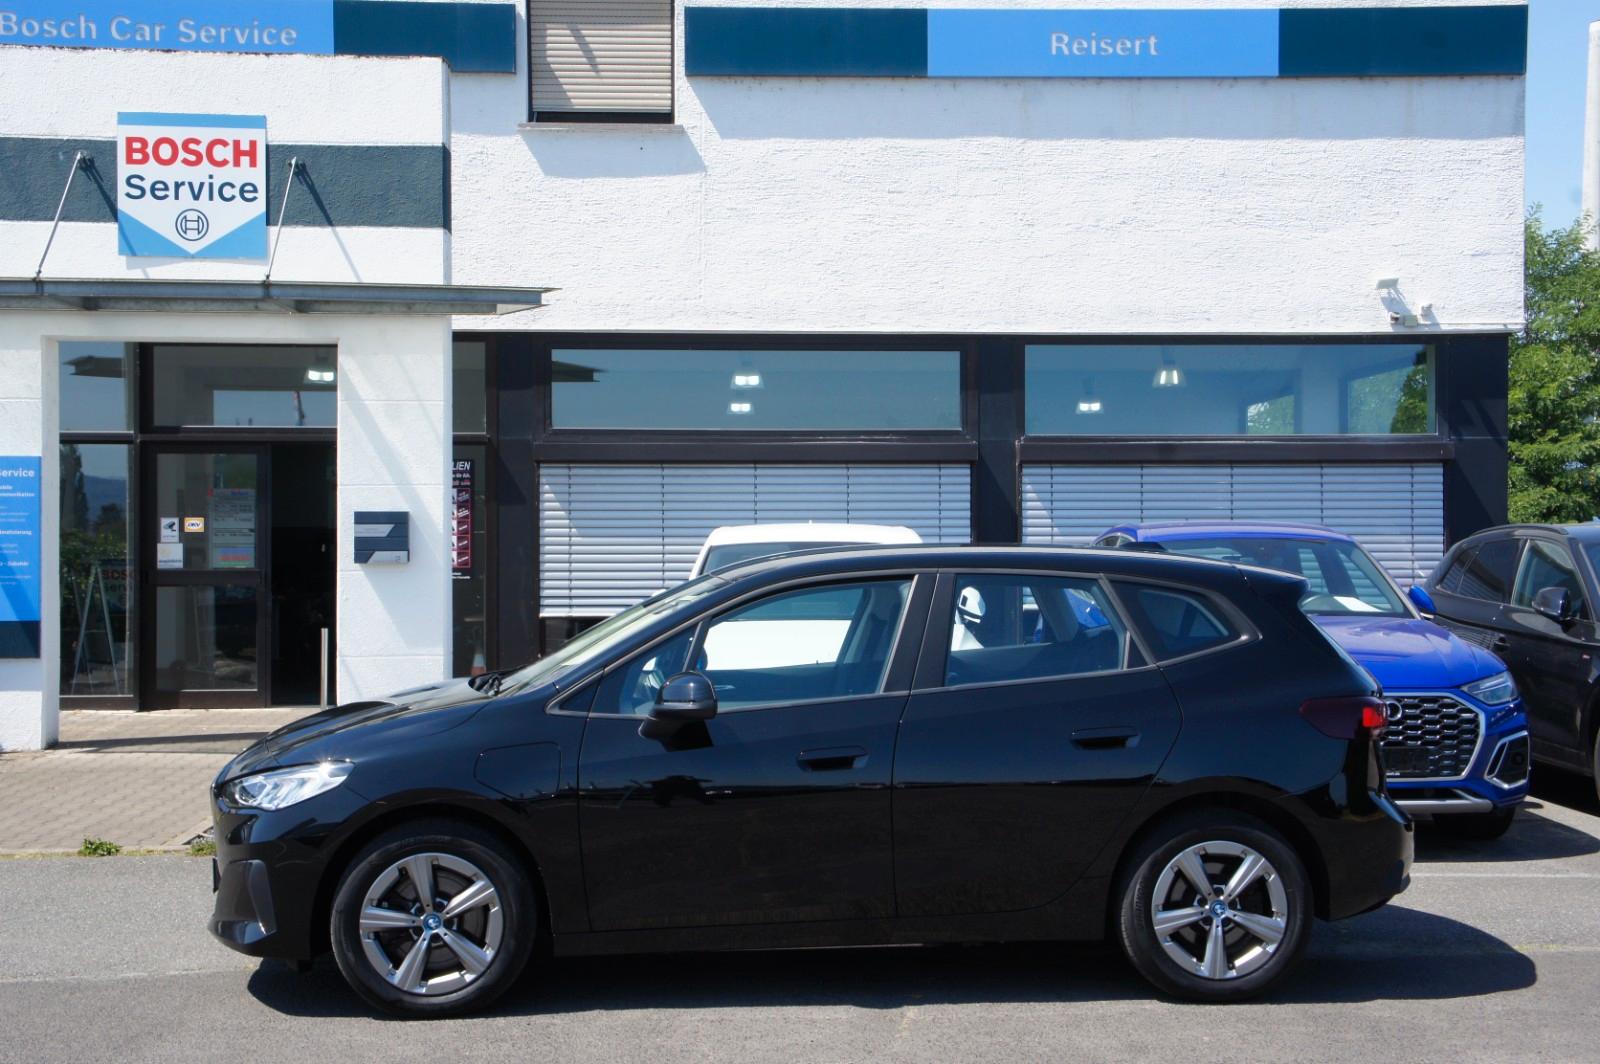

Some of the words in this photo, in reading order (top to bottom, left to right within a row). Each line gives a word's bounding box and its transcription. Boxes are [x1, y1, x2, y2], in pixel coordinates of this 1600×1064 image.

[0, 12, 97, 39] Bosch
[110, 16, 166, 41] Car
[178, 18, 297, 46] Service
[1051, 31, 1159, 56] Reisert
[125, 136, 257, 168] BOSCH
[124, 174, 259, 203] Service
[0, 468, 35, 478] ervice
